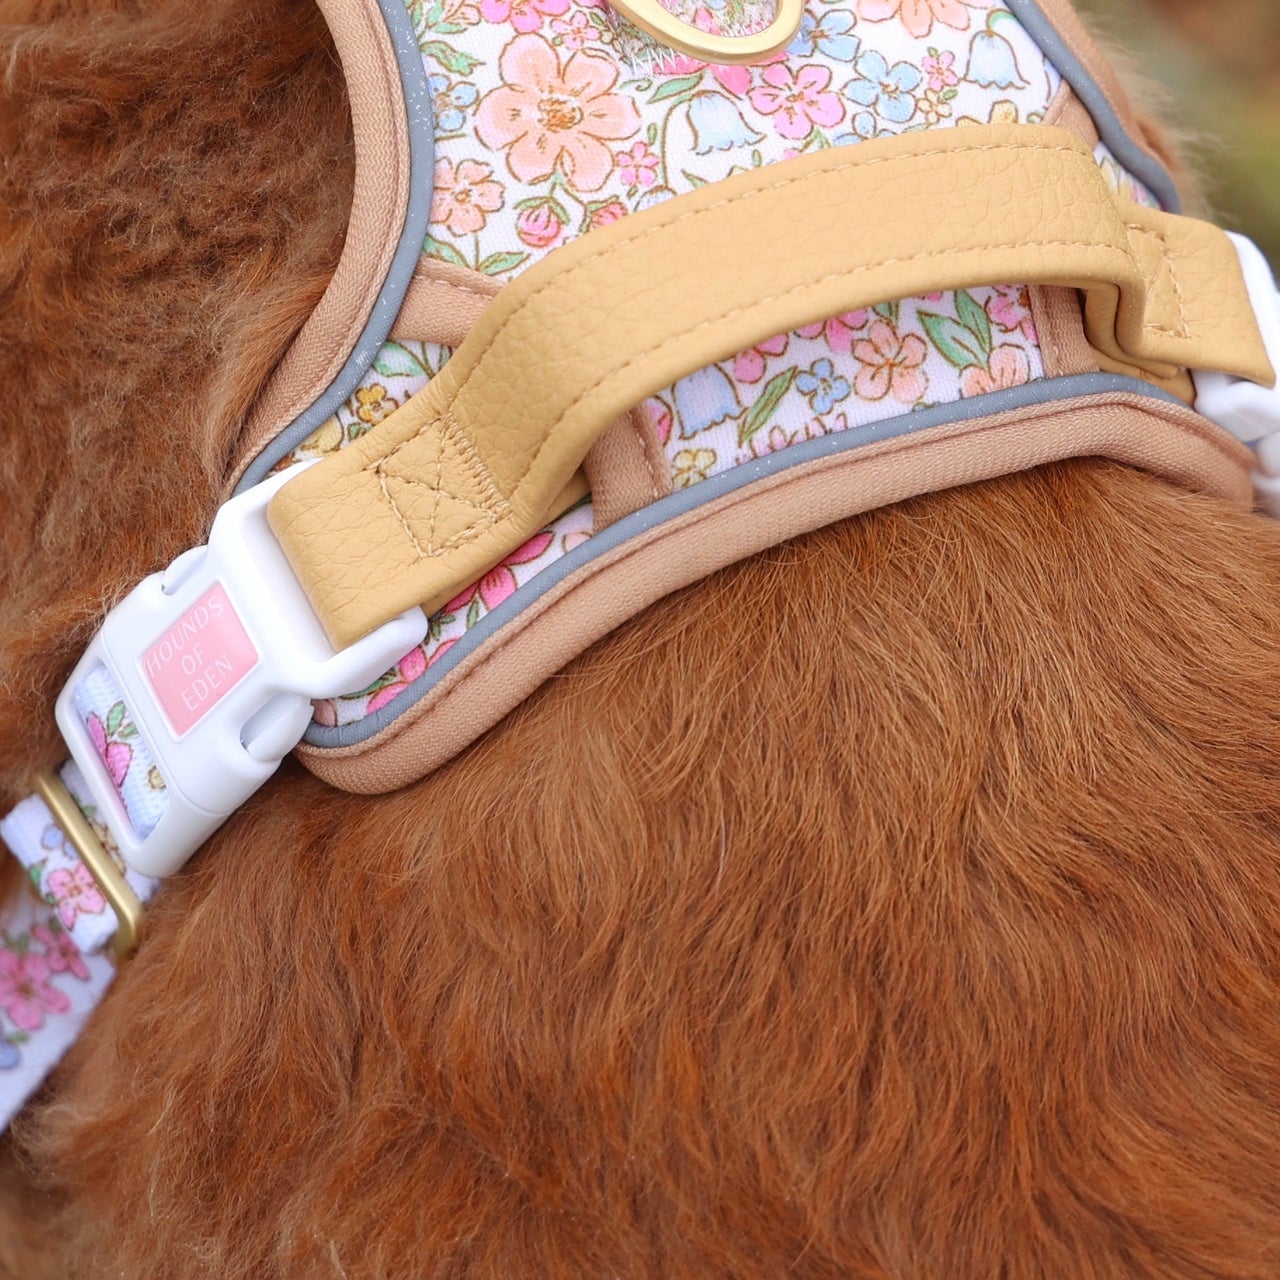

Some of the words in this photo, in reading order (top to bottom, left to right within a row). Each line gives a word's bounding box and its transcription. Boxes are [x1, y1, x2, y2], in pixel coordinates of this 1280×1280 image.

[145, 595, 224, 677] HOUNDS
[182, 641, 206, 675] OF
[181, 654, 234, 712] EDEN
